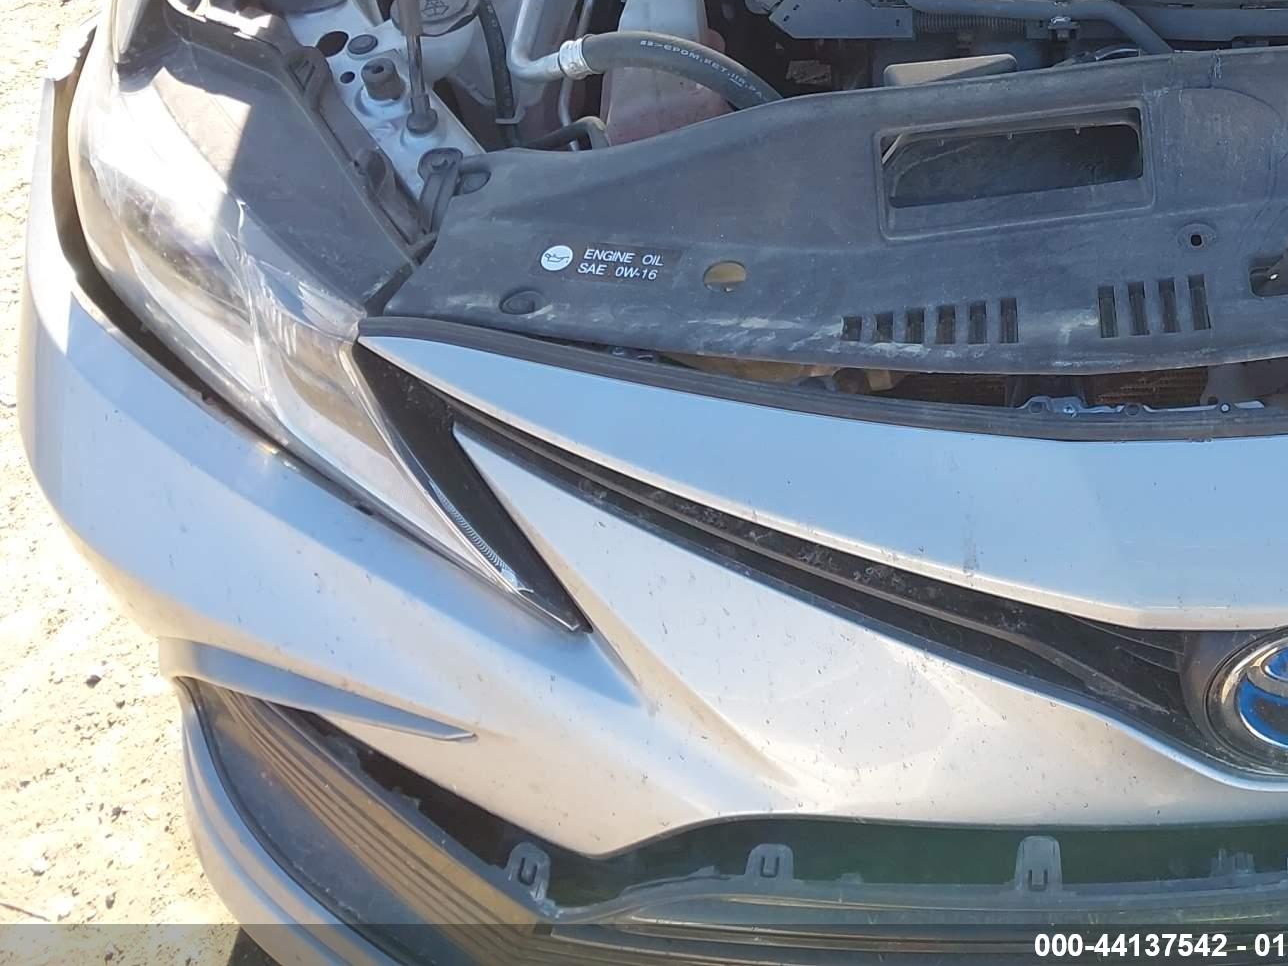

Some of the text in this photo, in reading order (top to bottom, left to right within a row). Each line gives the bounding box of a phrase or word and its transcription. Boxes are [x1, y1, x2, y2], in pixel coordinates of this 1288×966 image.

[584, 248, 664, 266] ENGINE OIL
[578, 263, 658, 280] SAE 0W-16
